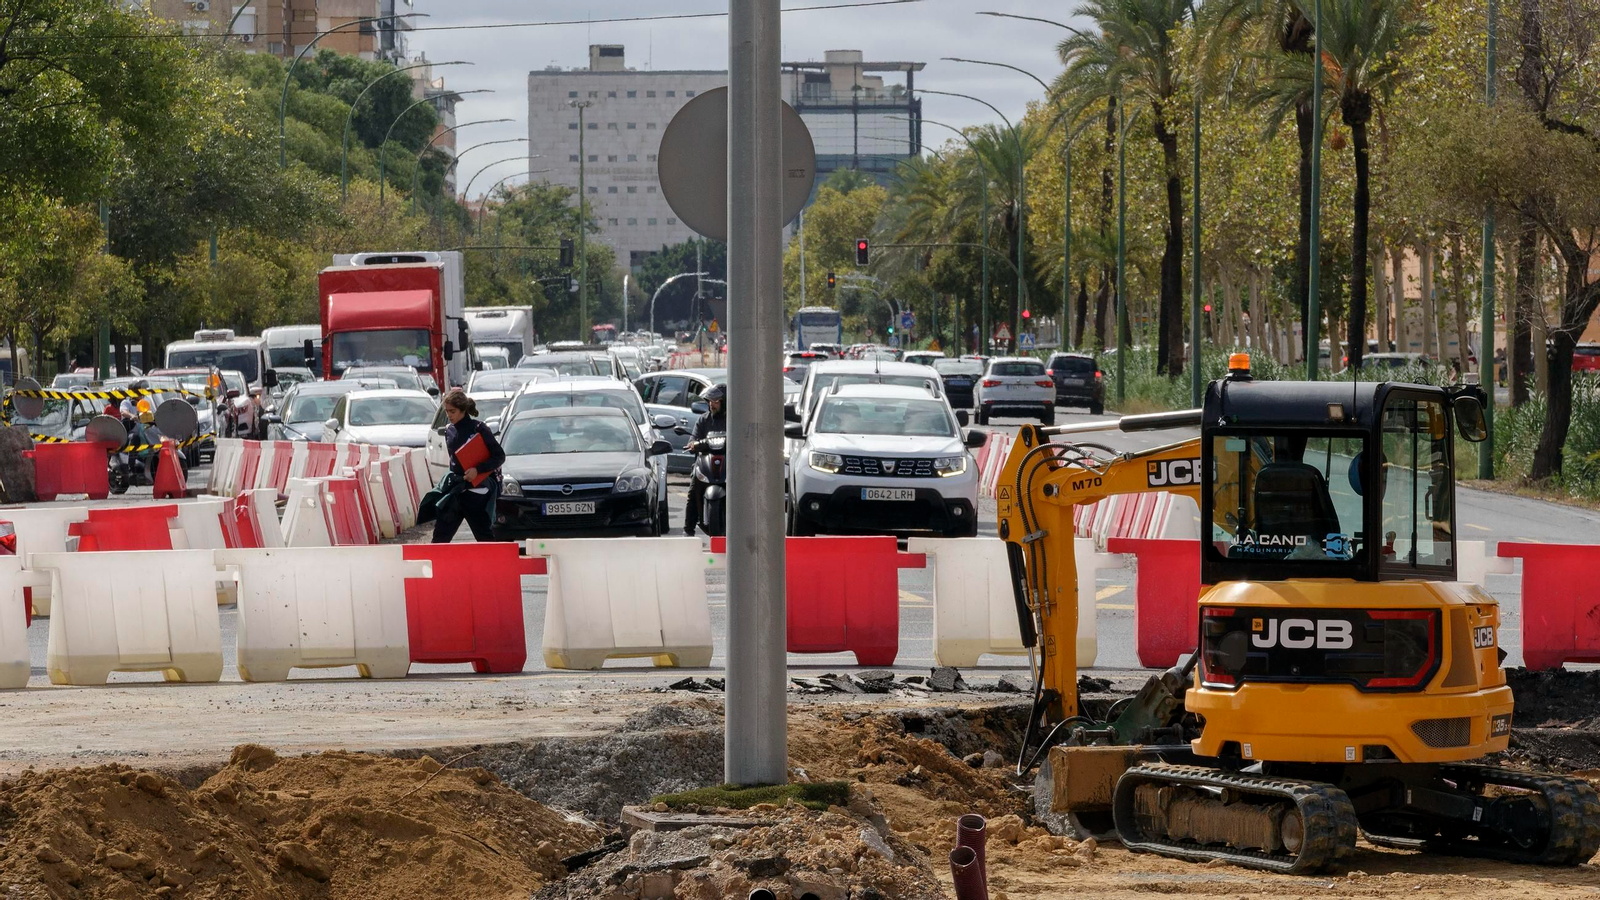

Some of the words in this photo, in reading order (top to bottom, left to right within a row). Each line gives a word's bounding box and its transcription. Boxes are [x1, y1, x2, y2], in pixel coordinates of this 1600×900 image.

[1072, 477, 1102, 491] M70
[867, 490, 892, 499] 0642
[894, 490, 913, 500] LRH
[547, 503, 572, 514] 9955
[574, 503, 593, 513] GZN
[1252, 618, 1353, 649] JCB
[1474, 627, 1494, 647] JCB
